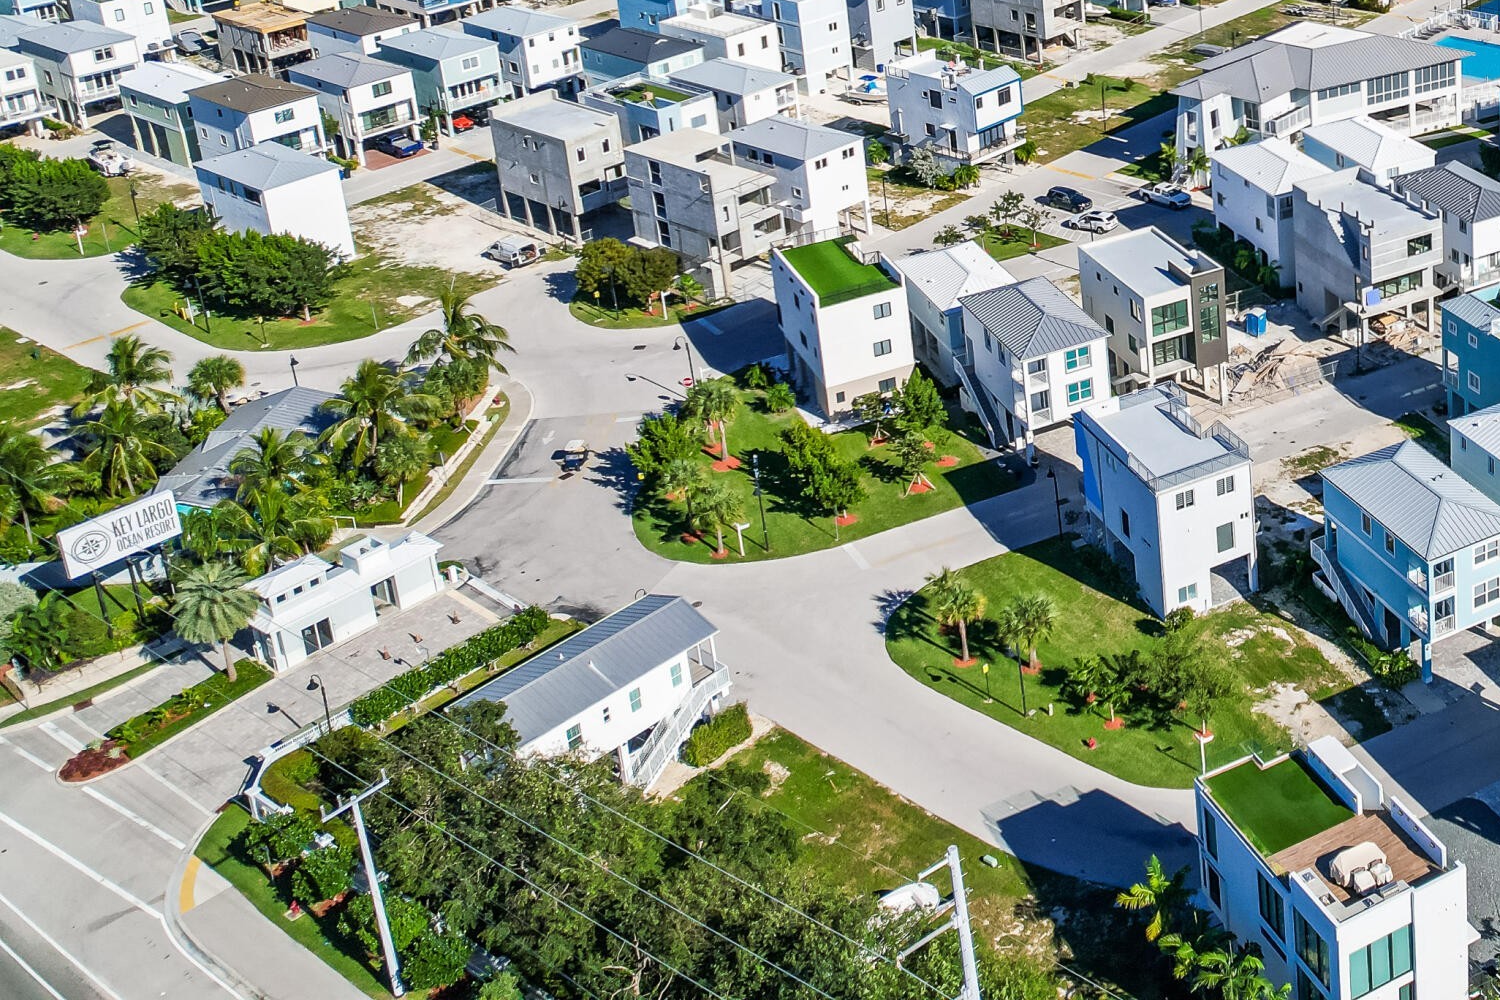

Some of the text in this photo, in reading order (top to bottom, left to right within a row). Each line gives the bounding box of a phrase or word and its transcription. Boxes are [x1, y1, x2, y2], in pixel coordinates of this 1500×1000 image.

[112, 499, 173, 537] KEY LARGO
[117, 517, 176, 552] OCEAN RESORT
